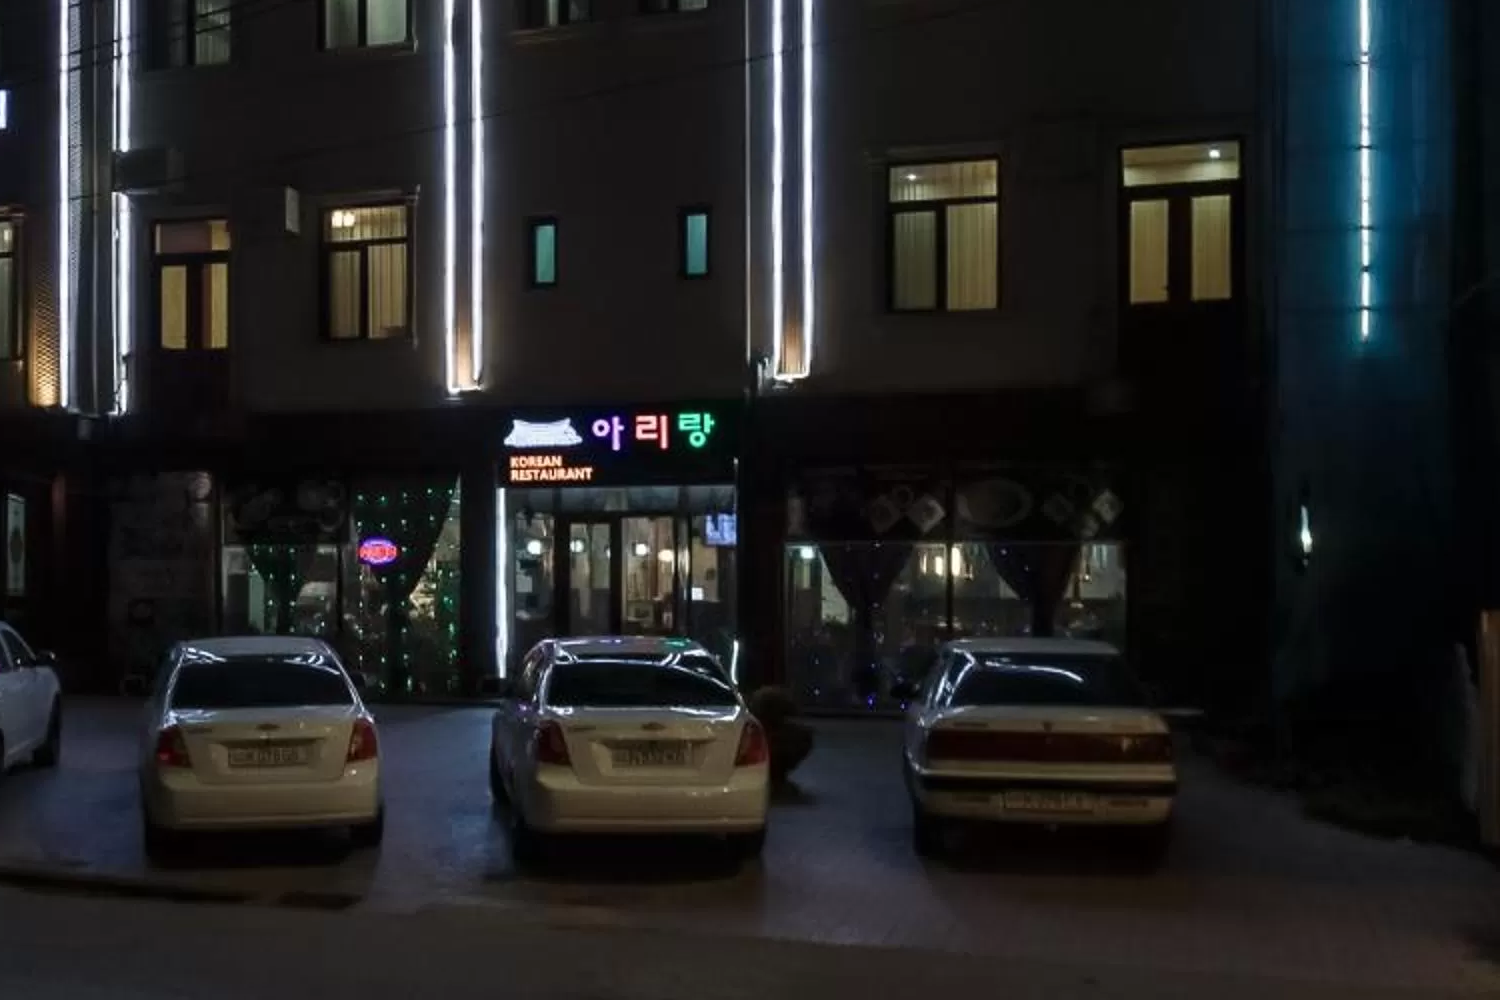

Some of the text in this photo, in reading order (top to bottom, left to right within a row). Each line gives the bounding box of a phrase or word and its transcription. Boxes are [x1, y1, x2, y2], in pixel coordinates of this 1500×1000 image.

[592, 413, 715, 451] 아리랑
[510, 455, 562, 468] KOREAN
[510, 467, 593, 482] RESTAURANT
